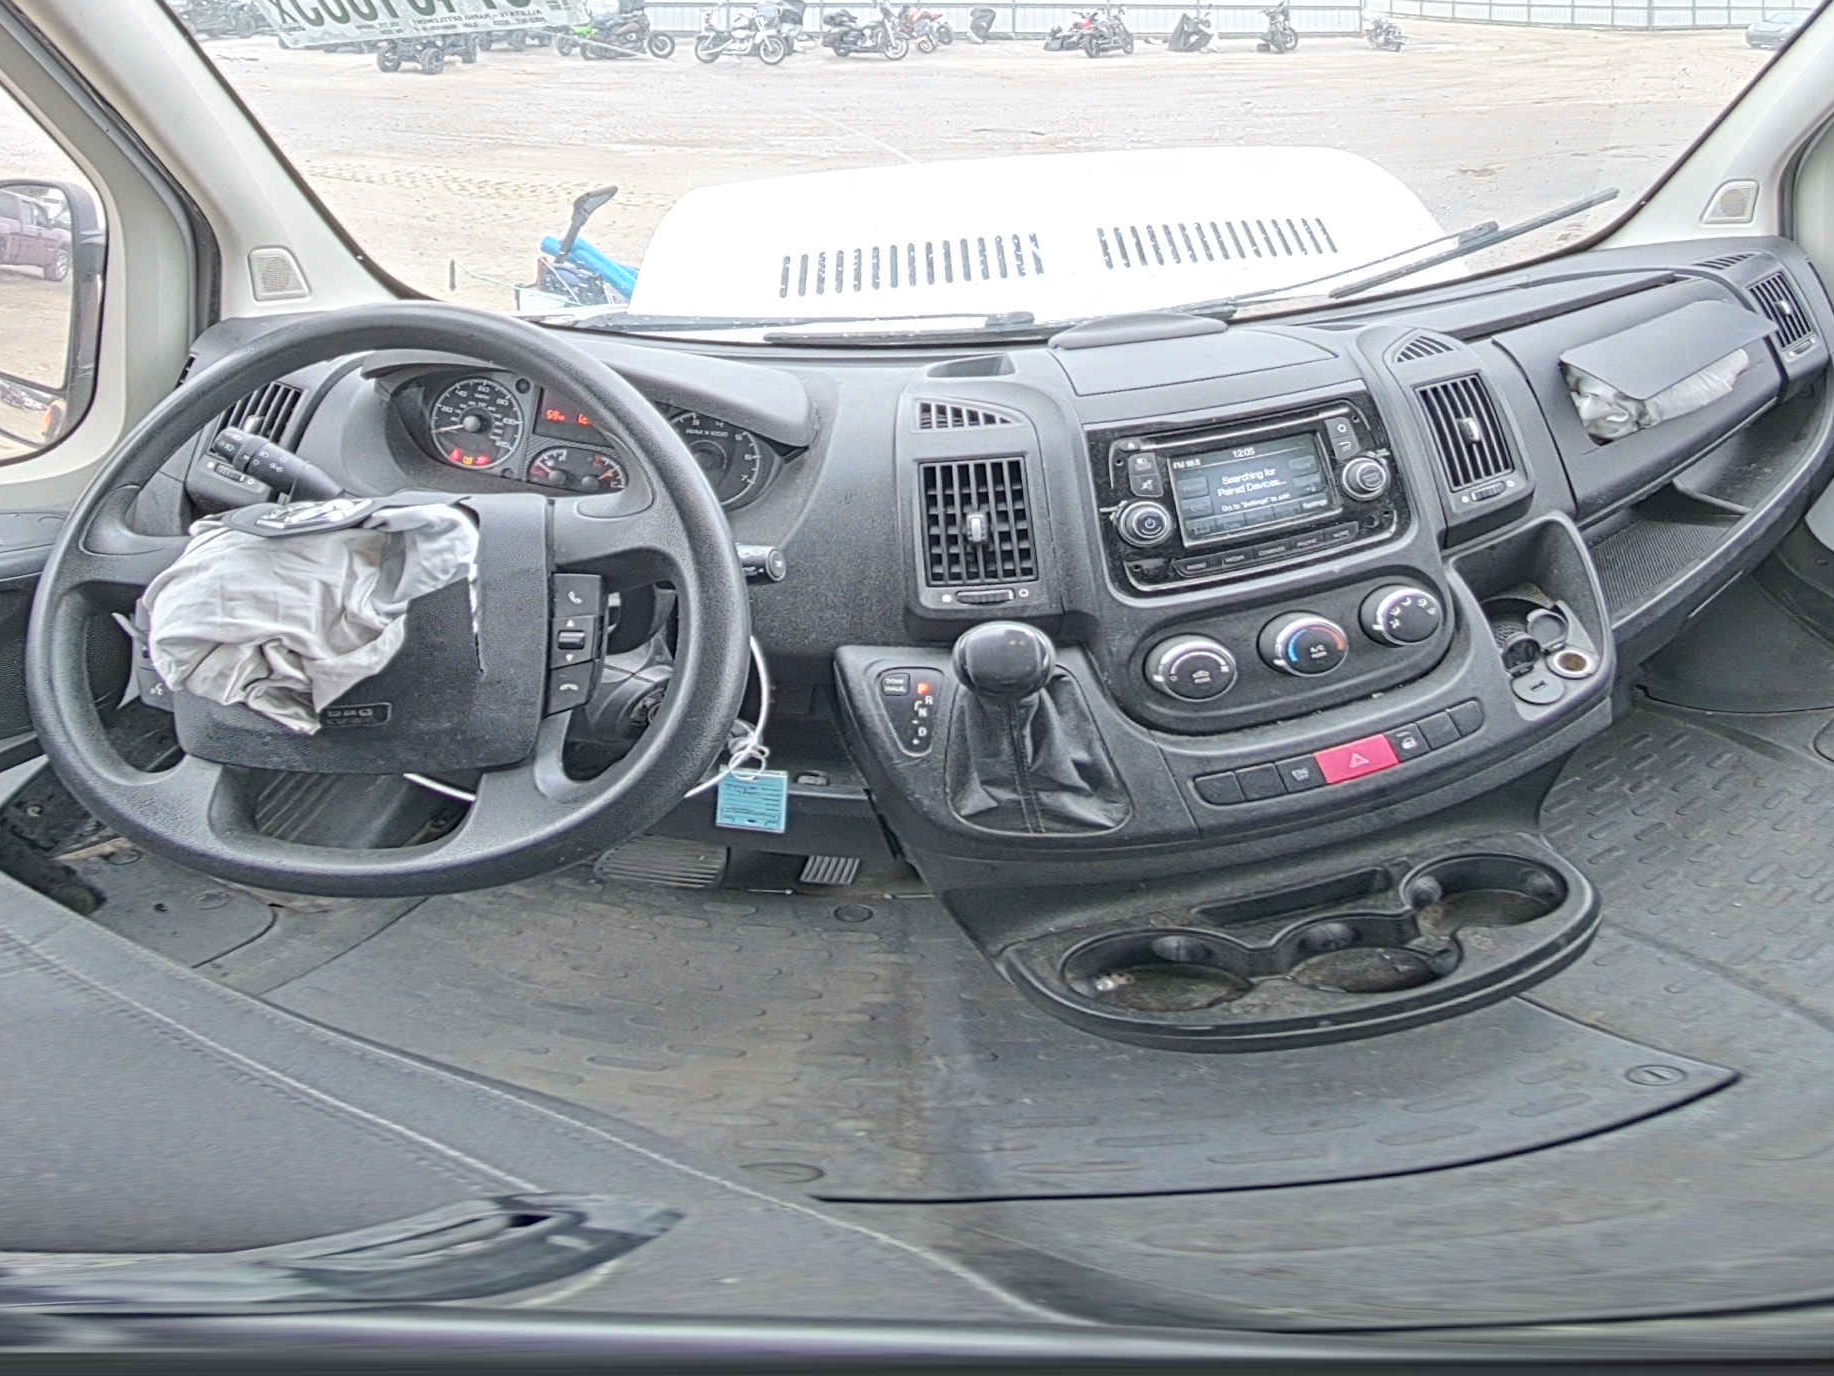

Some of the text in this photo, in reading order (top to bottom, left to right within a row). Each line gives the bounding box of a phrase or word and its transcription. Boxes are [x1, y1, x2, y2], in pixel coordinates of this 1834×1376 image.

[1232, 448, 1255, 458] 12:05
[1222, 468, 1276, 485] Searching for
[1217, 479, 1287, 497] Paired Devices...
[1302, 499, 1327, 509] Settings
[1225, 554, 1245, 562] MEDIA
[917, 683, 927, 694] P
[925, 696, 933, 706] R
[919, 708, 927, 718] N
[918, 727, 927, 737] D
